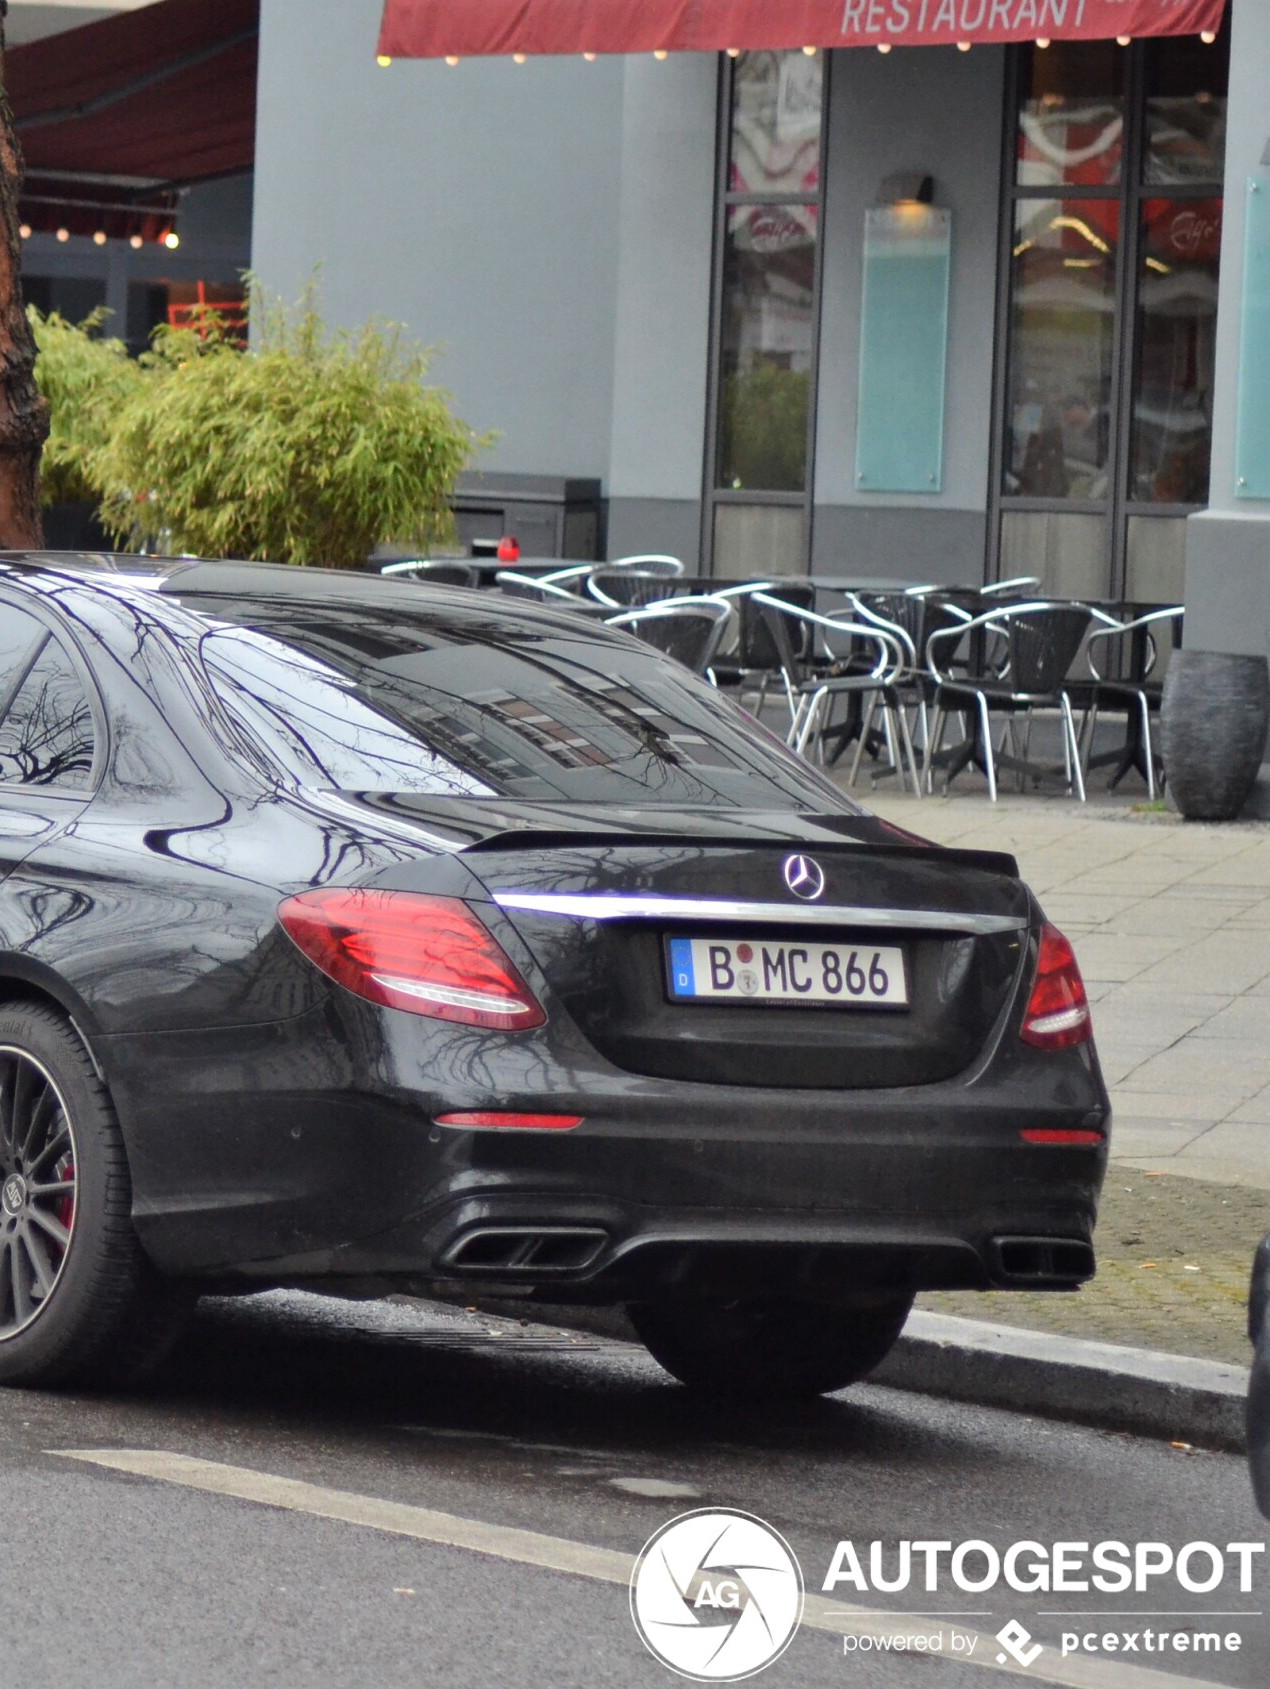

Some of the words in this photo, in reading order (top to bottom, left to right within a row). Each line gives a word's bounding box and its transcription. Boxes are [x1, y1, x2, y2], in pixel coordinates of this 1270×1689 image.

[841, 0, 1085, 34] RESTAURANT
[679, 973, 688, 987] D
[708, 945, 735, 990] B
[761, 947, 812, 993] MC
[821, 950, 890, 996] 866
